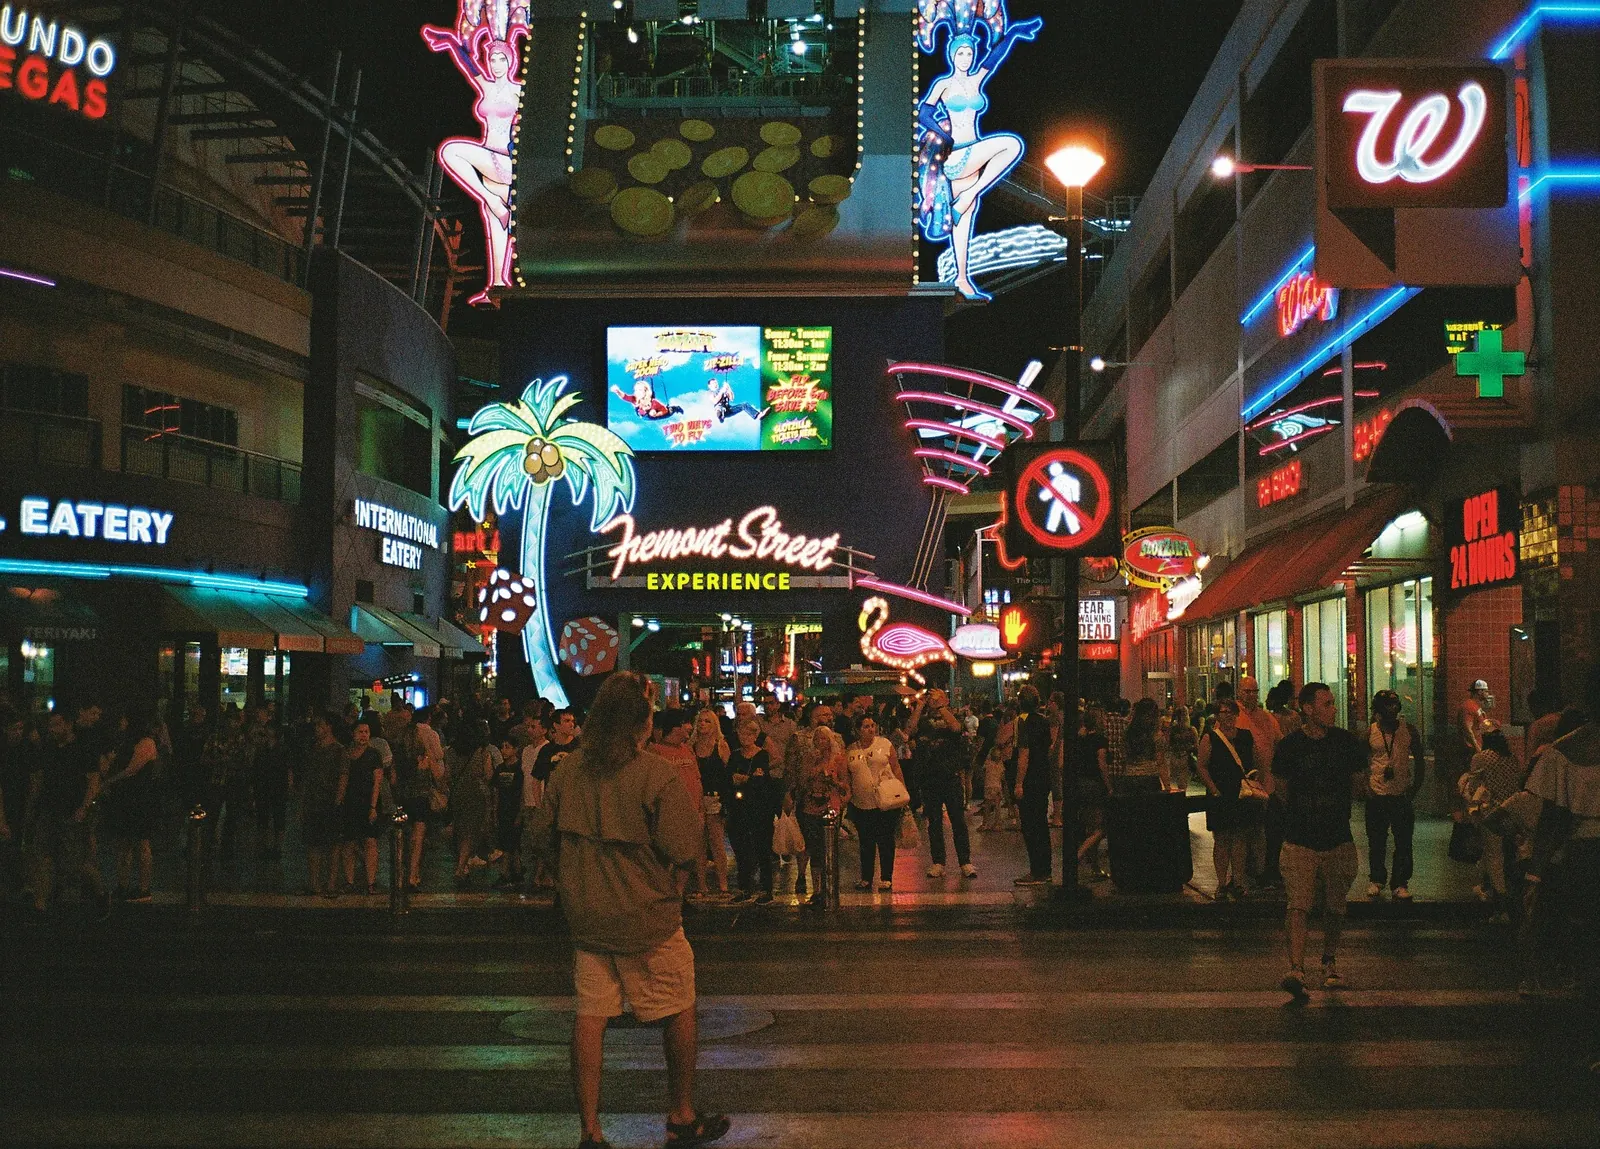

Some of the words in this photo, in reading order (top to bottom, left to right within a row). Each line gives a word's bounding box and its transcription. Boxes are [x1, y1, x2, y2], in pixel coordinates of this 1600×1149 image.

[1342, 80, 1487, 183] W
[791, 374, 810, 386] FLY
[766, 388, 807, 402] BEFORE
[662, 422, 684, 434] TWO
[674, 433, 685, 443] TO
[687, 431, 703, 441] FLY
[20, 499, 174, 545] EATERY
[354, 498, 438, 549] INTERNATIONAL
[1463, 489, 1498, 543] OPEN
[600, 513, 733, 581] Fremont
[728, 505, 840, 571] Street
[382, 537, 422, 570] EATERY
[1450, 545, 1467, 589] 24
[1467, 531, 1515, 586] HOURS
[647, 572, 790, 590] EXPERIENCE
[1079, 601, 1104, 614] FEAR
[1079, 614, 1112, 623] WALKING
[1079, 623, 1112, 640] DEAD
[1091, 646, 1113, 656] VIVA
